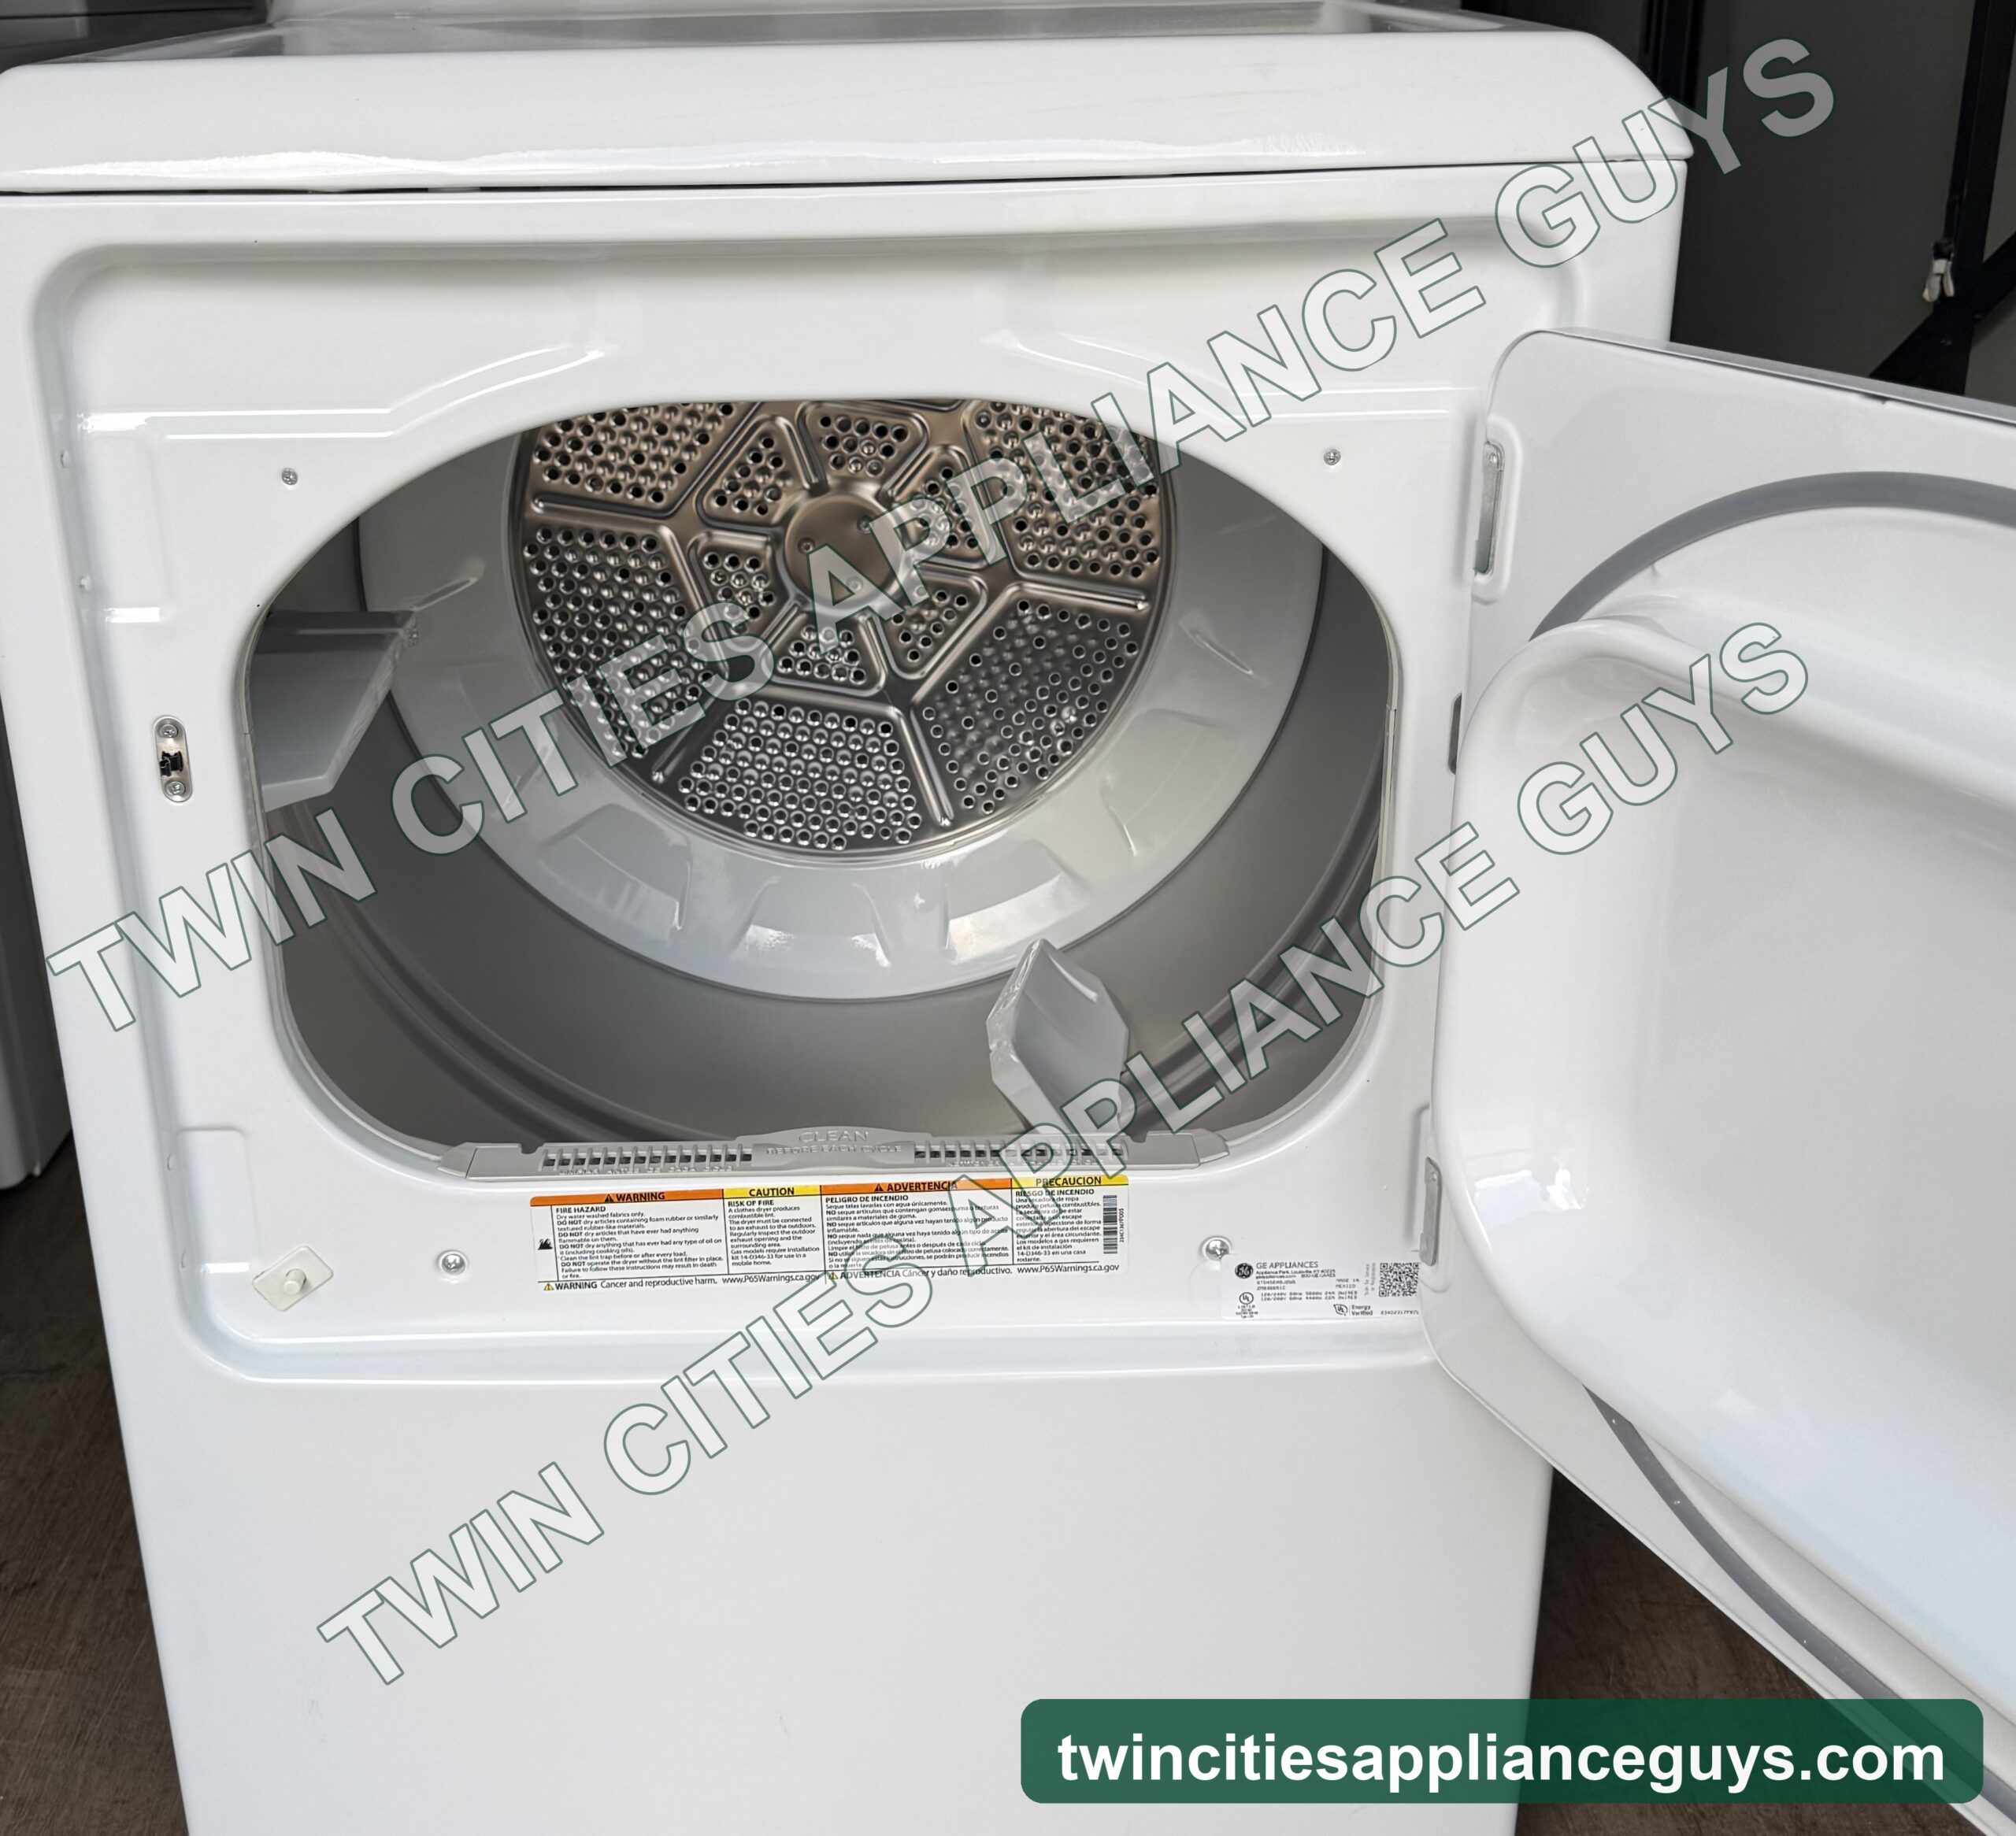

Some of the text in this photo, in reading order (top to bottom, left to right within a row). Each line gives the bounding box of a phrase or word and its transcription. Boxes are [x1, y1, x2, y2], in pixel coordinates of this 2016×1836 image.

[799, 1131, 869, 1142] CLEAN
[766, 1146, 817, 1154] BEFORE
[1036, 1176, 1102, 1186] PRECAUCION
[887, 1182, 958, 1191] ADVERTENCIA
[616, 1192, 665, 1202] WARNING
[749, 1187, 795, 1197] CAUTION
[840, 1270, 900, 1279] ADVERTENCIA
[902, 1268, 929, 1278] Cáncer
[937, 1268, 958, 1277] daño
[959, 1267, 1012, 1277] reproductivo.
[1017, 1264, 1119, 1274] www.P65Warnings.ca.gov
[555, 1281, 597, 1290] WARNING
[645, 1278, 694, 1288] reproductive
[722, 1273, 820, 1284] www.P65Warnings.ca.gov
